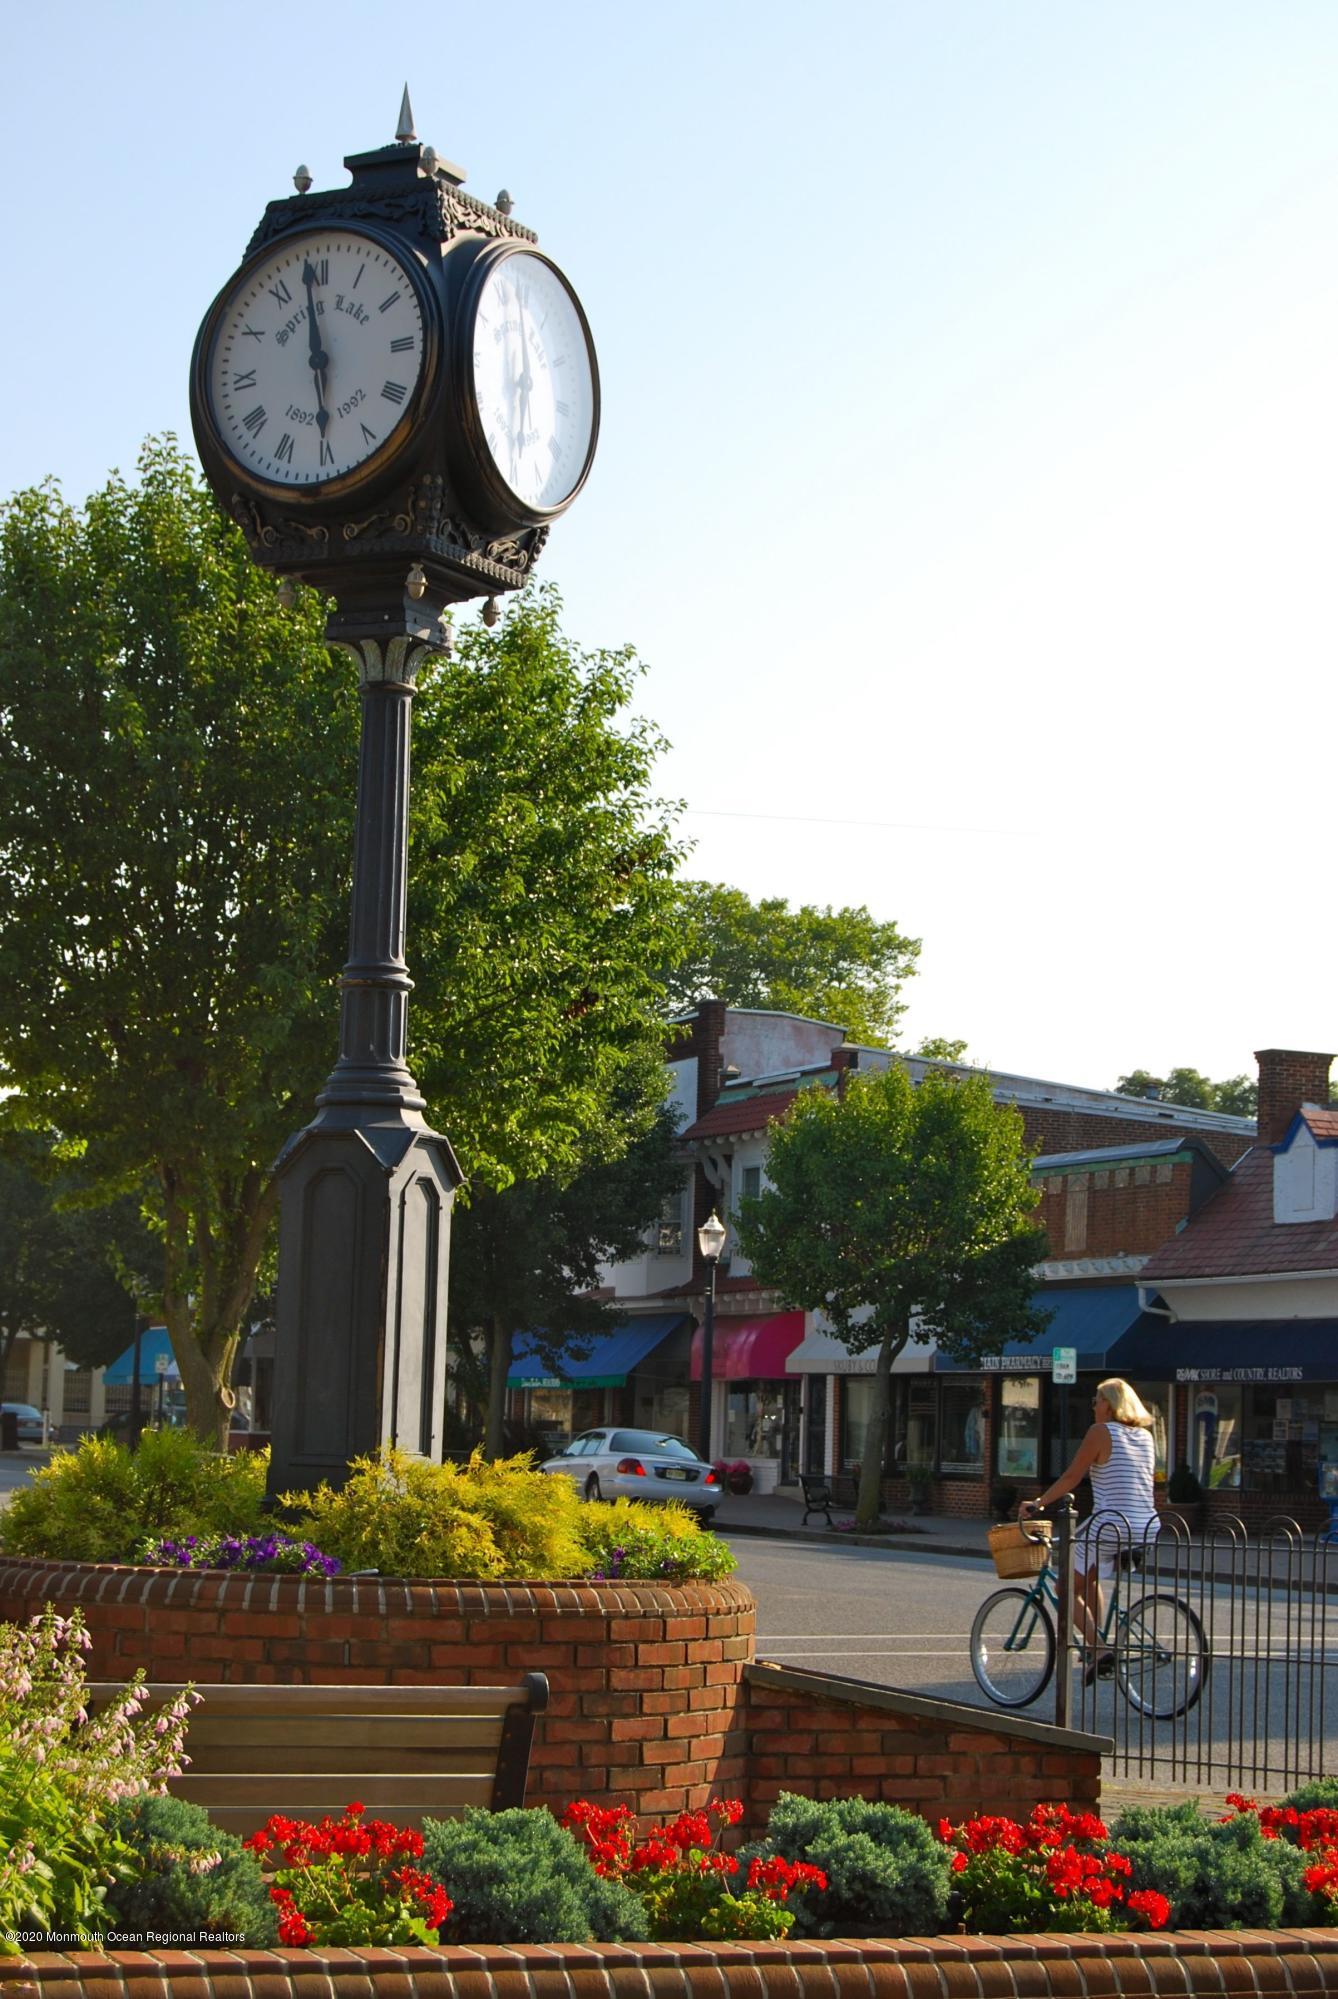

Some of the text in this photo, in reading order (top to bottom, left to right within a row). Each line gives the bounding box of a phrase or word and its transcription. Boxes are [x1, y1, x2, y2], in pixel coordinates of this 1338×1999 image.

[353, 263, 365, 289] I
[269, 279, 292, 311] XI
[379, 290, 401, 314] II
[275, 294, 370, 347] Sprig Lake
[241, 325, 265, 343] X
[390, 336, 415, 353] III
[233, 369, 257, 392] IX
[285, 388, 366, 427] 1892 1992
[242, 405, 268, 439] VIII
[360, 422, 376, 445] V
[274, 433, 295, 464] VII
[320, 440, 334, 467] VI
[1001, 1355, 1040, 1369] PHARMACY
[1200, 1368, 1221, 1380] SHORE
[1222, 1368, 1232, 1380] and
